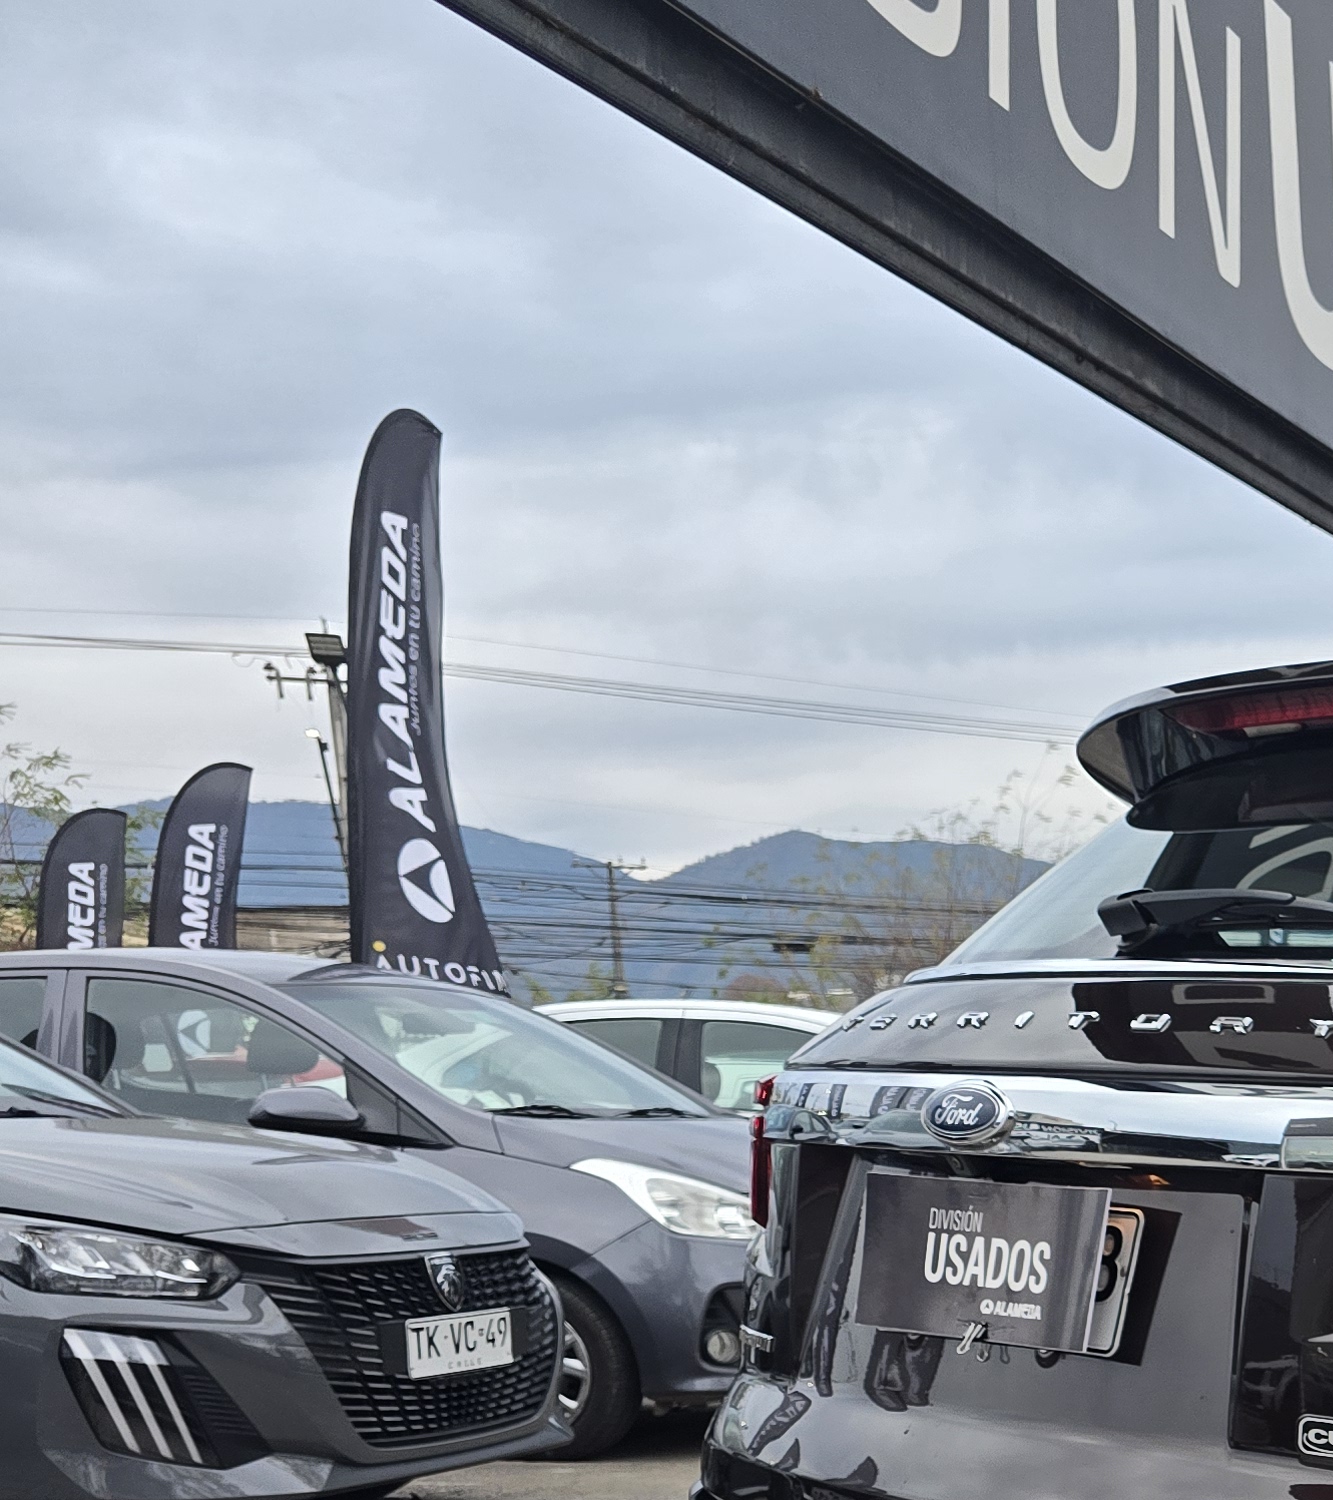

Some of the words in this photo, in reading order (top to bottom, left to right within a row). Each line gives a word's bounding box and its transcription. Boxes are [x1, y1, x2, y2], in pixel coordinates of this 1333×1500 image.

[378, 511, 437, 832] ALAMEDA
[934, 1093, 984, 1126] Ford
[929, 1205, 984, 1233] DIVISIÓN
[924, 1231, 1051, 1294] USADOS
[993, 1300, 1042, 1320] ALAMEDA
